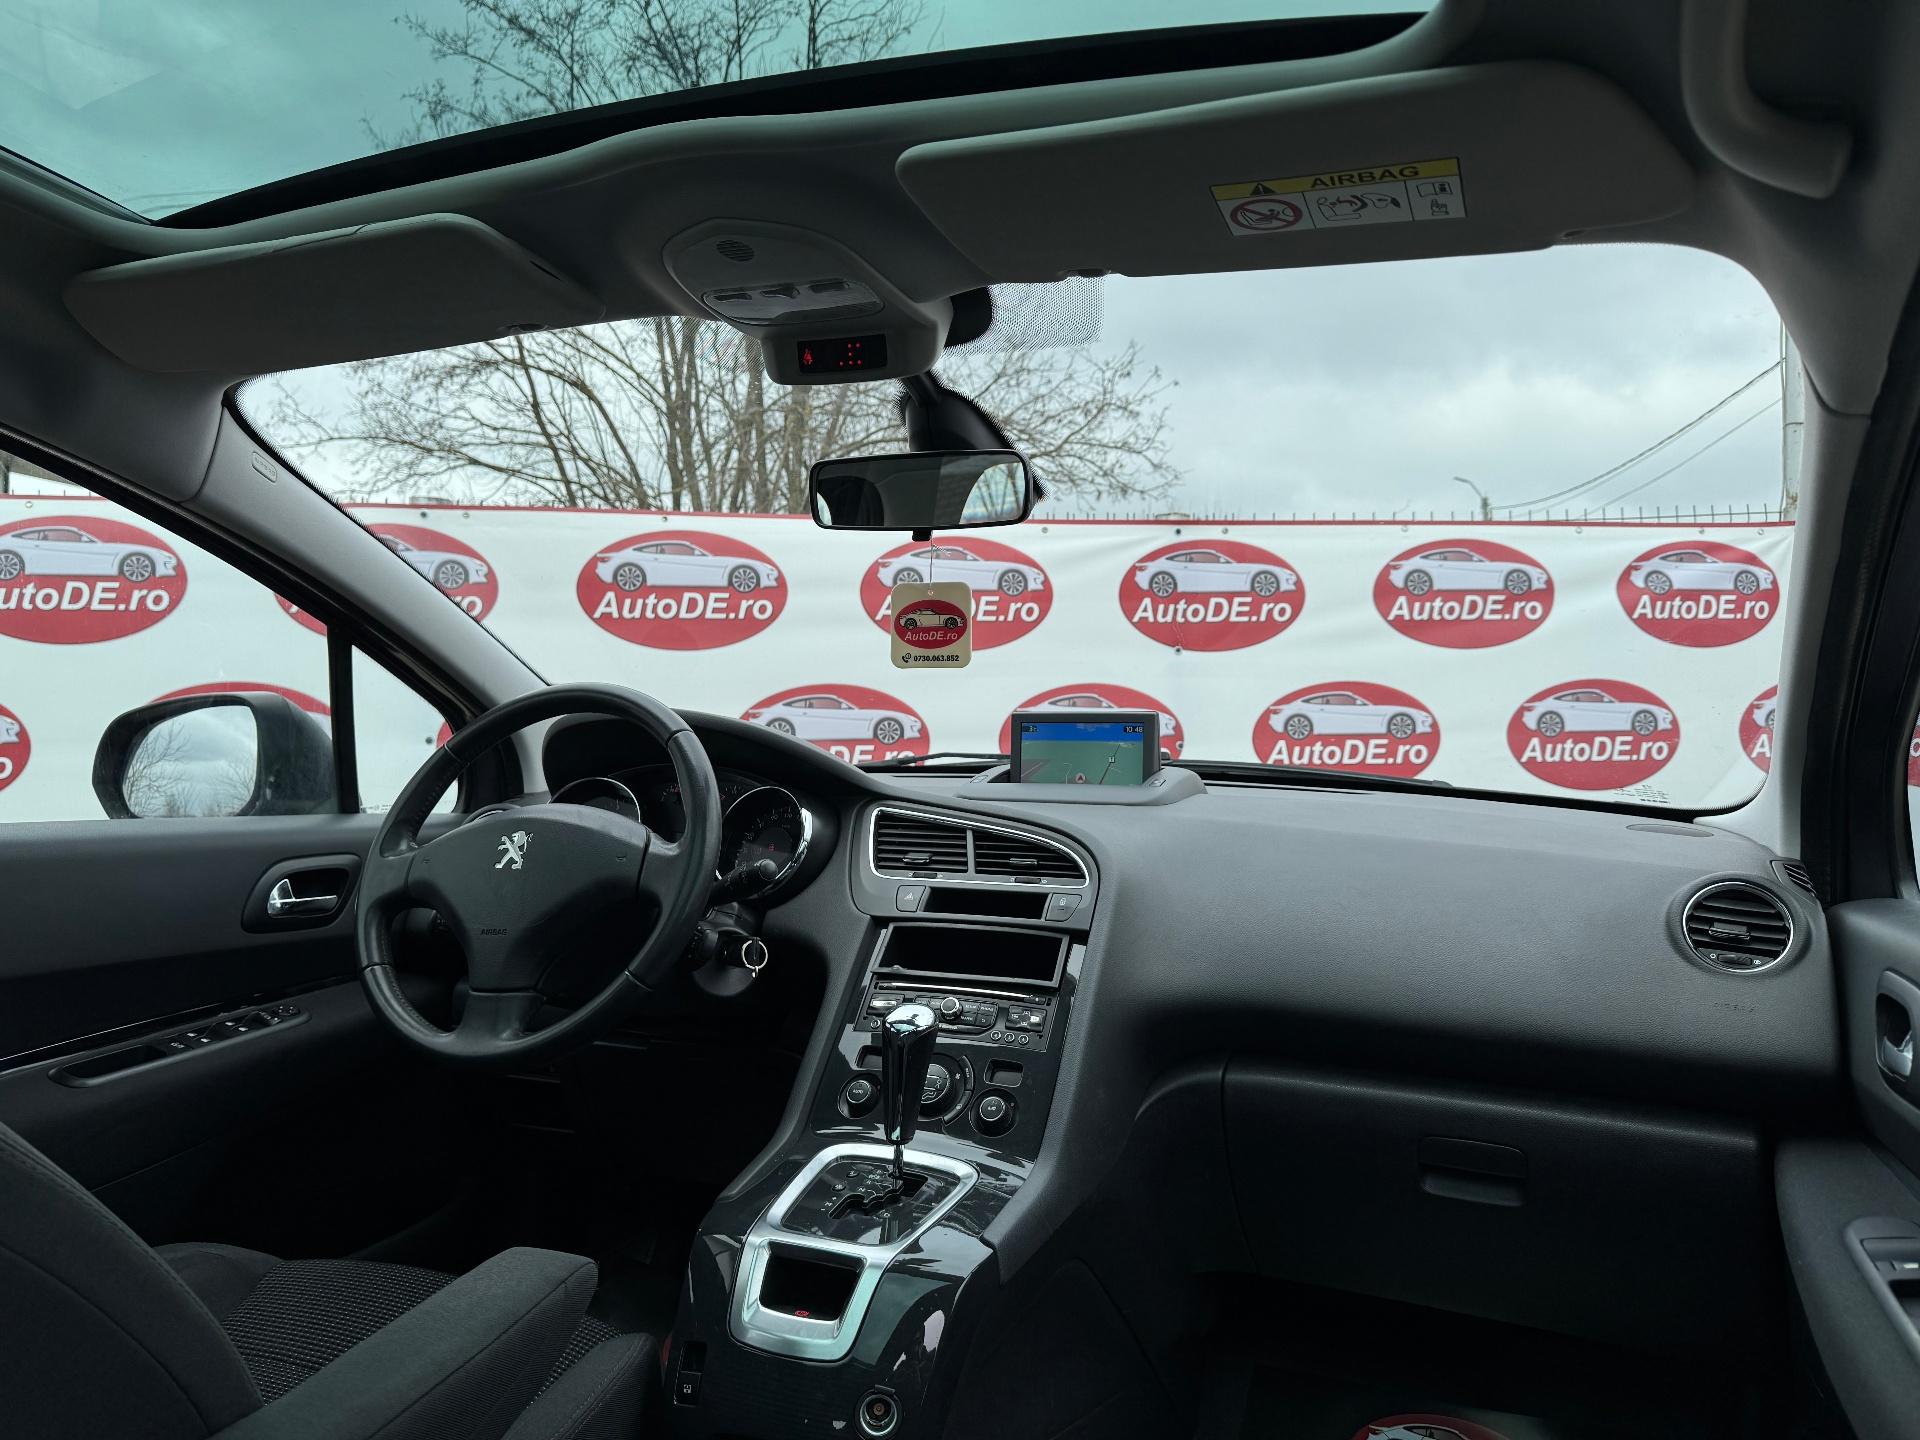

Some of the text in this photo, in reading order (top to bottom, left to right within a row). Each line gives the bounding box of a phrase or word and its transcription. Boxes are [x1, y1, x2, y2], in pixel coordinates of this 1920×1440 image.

[1311, 166, 1420, 189] AIRBAG
[0, 580, 170, 611] utoDE.ro
[593, 591, 773, 620] AutoDE.ro
[1387, 595, 1543, 621] AutoDE.ro
[1632, 594, 1770, 620] AutoDE.ro
[1132, 597, 1292, 623] AutoDE.ro
[904, 631, 959, 641] AutoDE.ro
[1266, 739, 1429, 765] AutoDE.ro
[1520, 736, 1669, 763] AutoDE.ro
